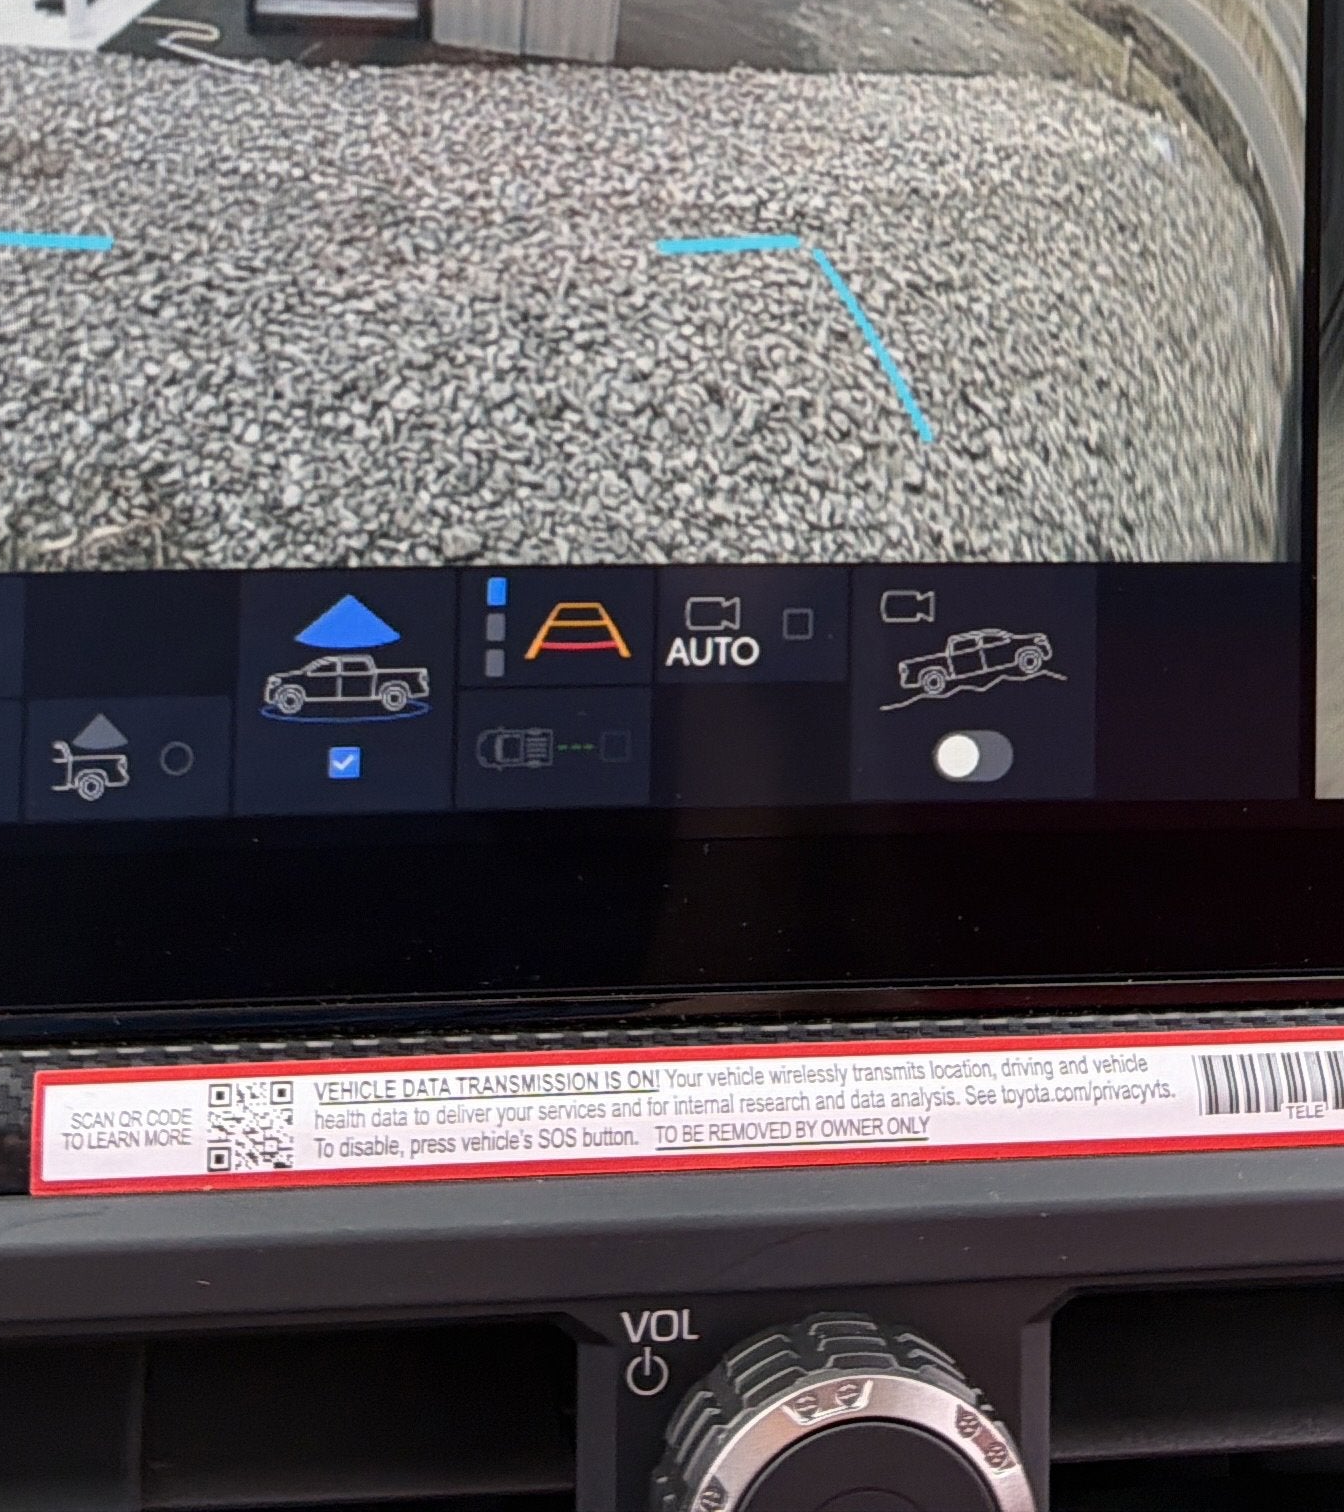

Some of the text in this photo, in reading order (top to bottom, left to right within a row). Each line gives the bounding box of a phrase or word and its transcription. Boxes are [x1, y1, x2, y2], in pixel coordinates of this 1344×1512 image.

[665, 636, 760, 667] AUTO
[314, 1053, 1148, 1101] VEHICLE DATA TRANSMISSION IS ON! Your vehicle wirelessly transmits location, driving and vehicle
[71, 1108, 192, 1130] SCAN QR CODE
[314, 1109, 365, 1129] health
[371, 1108, 408, 1128] data
[414, 1106, 430, 1126] to
[436, 1104, 492, 1125] deliver
[496, 1106, 533, 1127] your
[538, 1100, 606, 1120] services
[611, 1097, 642, 1118] and
[647, 1096, 669, 1116] for
[674, 1093, 734, 1115] internal
[739, 1090, 810, 1113] research
[815, 1090, 845, 1110] and
[851, 1088, 885, 1109] data
[891, 1086, 961, 1112] analysis.
[965, 1085, 997, 1106] See
[1285, 1104, 1324, 1120] TELE
[63, 1128, 192, 1150] TO LEARN MORE
[315, 1115, 931, 1159] To disable, press vehicle's SOS button. TO BE REMOVED BY OWNER ONLY
[619, 1308, 701, 1343] VOL
